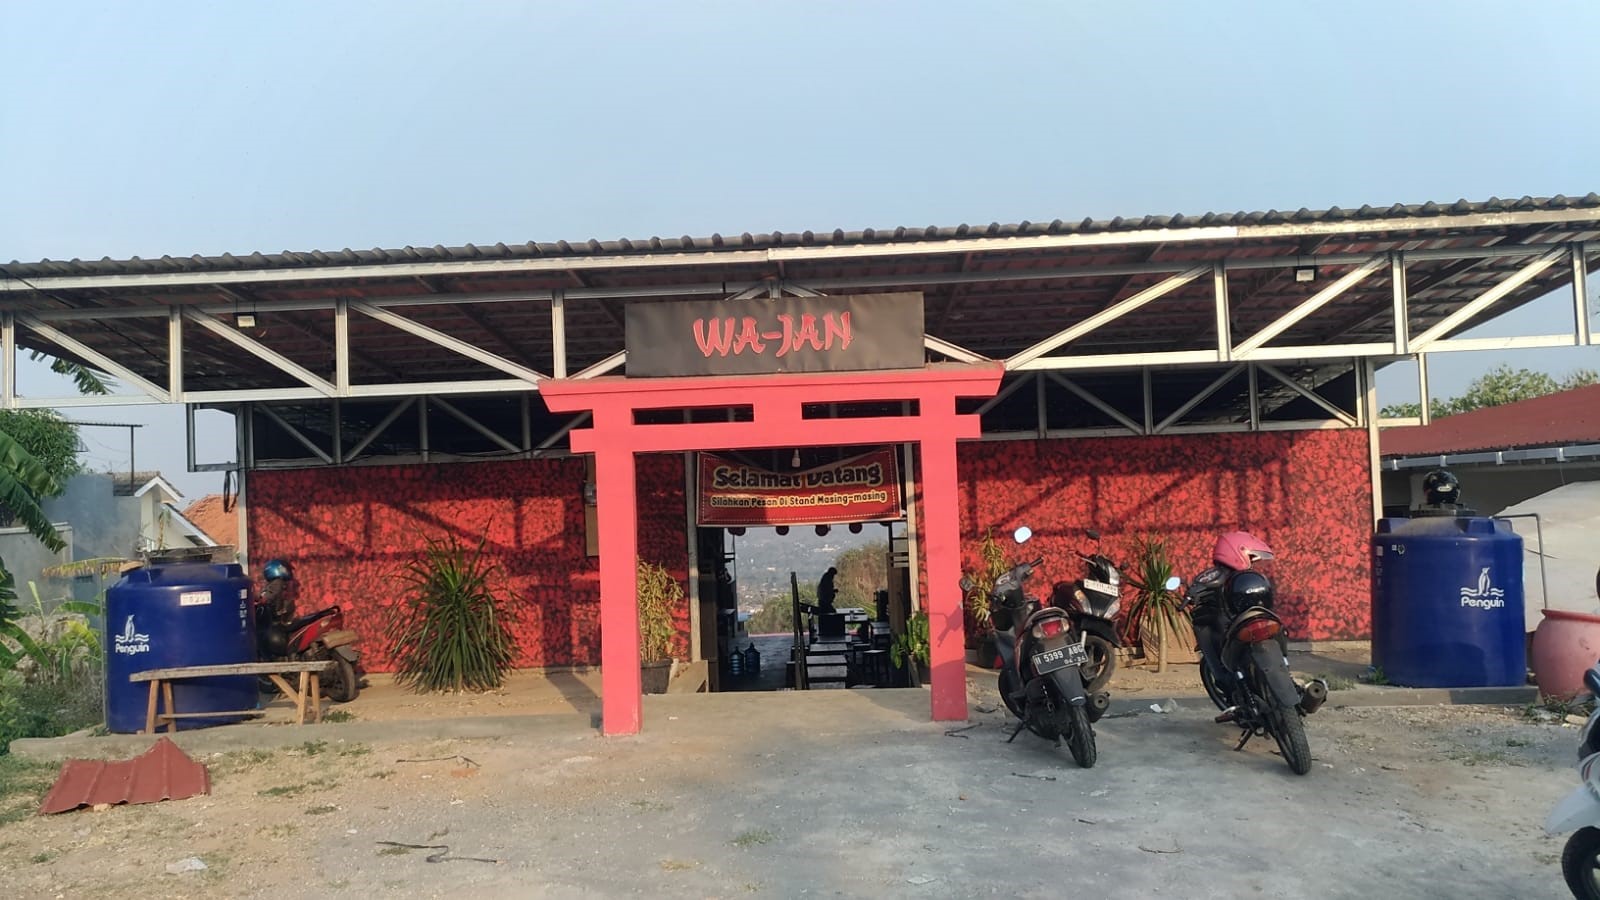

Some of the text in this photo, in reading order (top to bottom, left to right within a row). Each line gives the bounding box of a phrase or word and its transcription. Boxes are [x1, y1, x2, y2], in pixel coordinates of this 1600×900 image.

[693, 311, 853, 357] WA-JAN
[713, 462, 882, 489] Selamat Datang
[711, 491, 886, 507] Silahkan Pesan Di Stand Masing-masing
[1461, 596, 1504, 610] Penguin
[115, 642, 150, 655] Penguin
[1043, 651, 1063, 662] 5399
